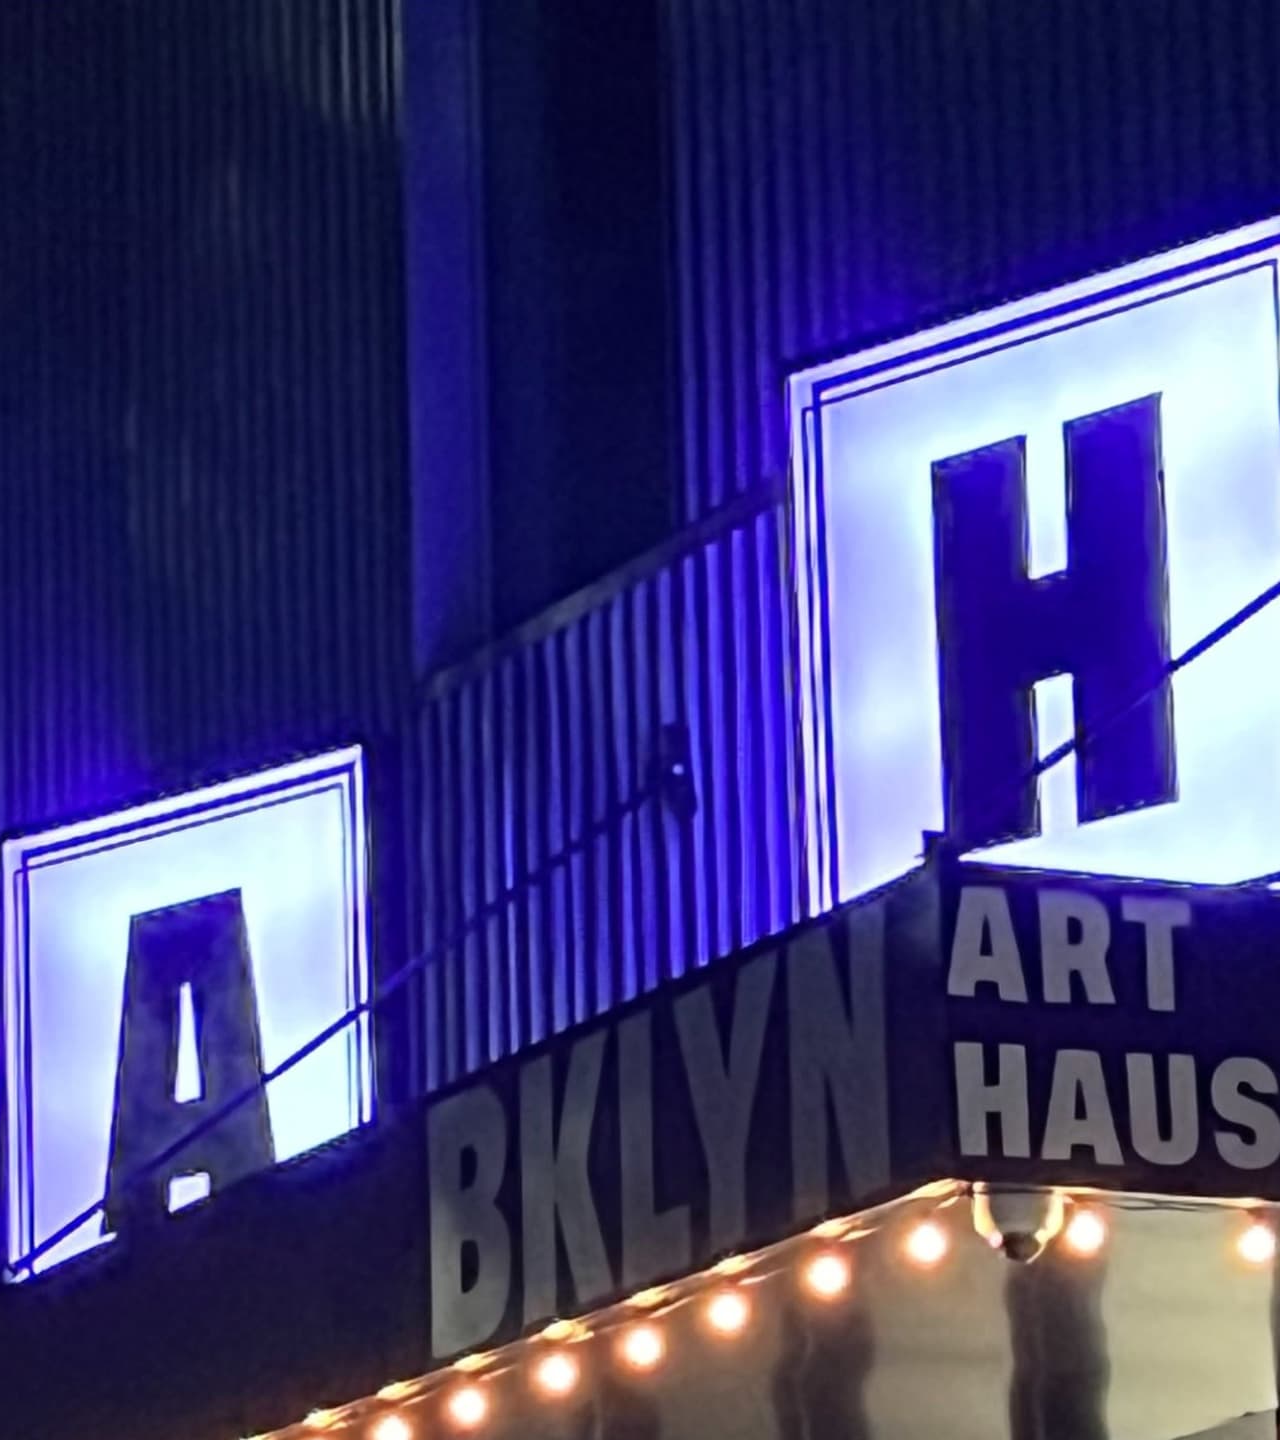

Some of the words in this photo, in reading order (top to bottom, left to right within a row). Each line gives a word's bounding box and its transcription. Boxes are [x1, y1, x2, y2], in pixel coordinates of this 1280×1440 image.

[102, 887, 277, 1234] A
[931, 391, 1180, 860] H
[947, 884, 1193, 1012] ART
[425, 898, 891, 1360] BKLYN
